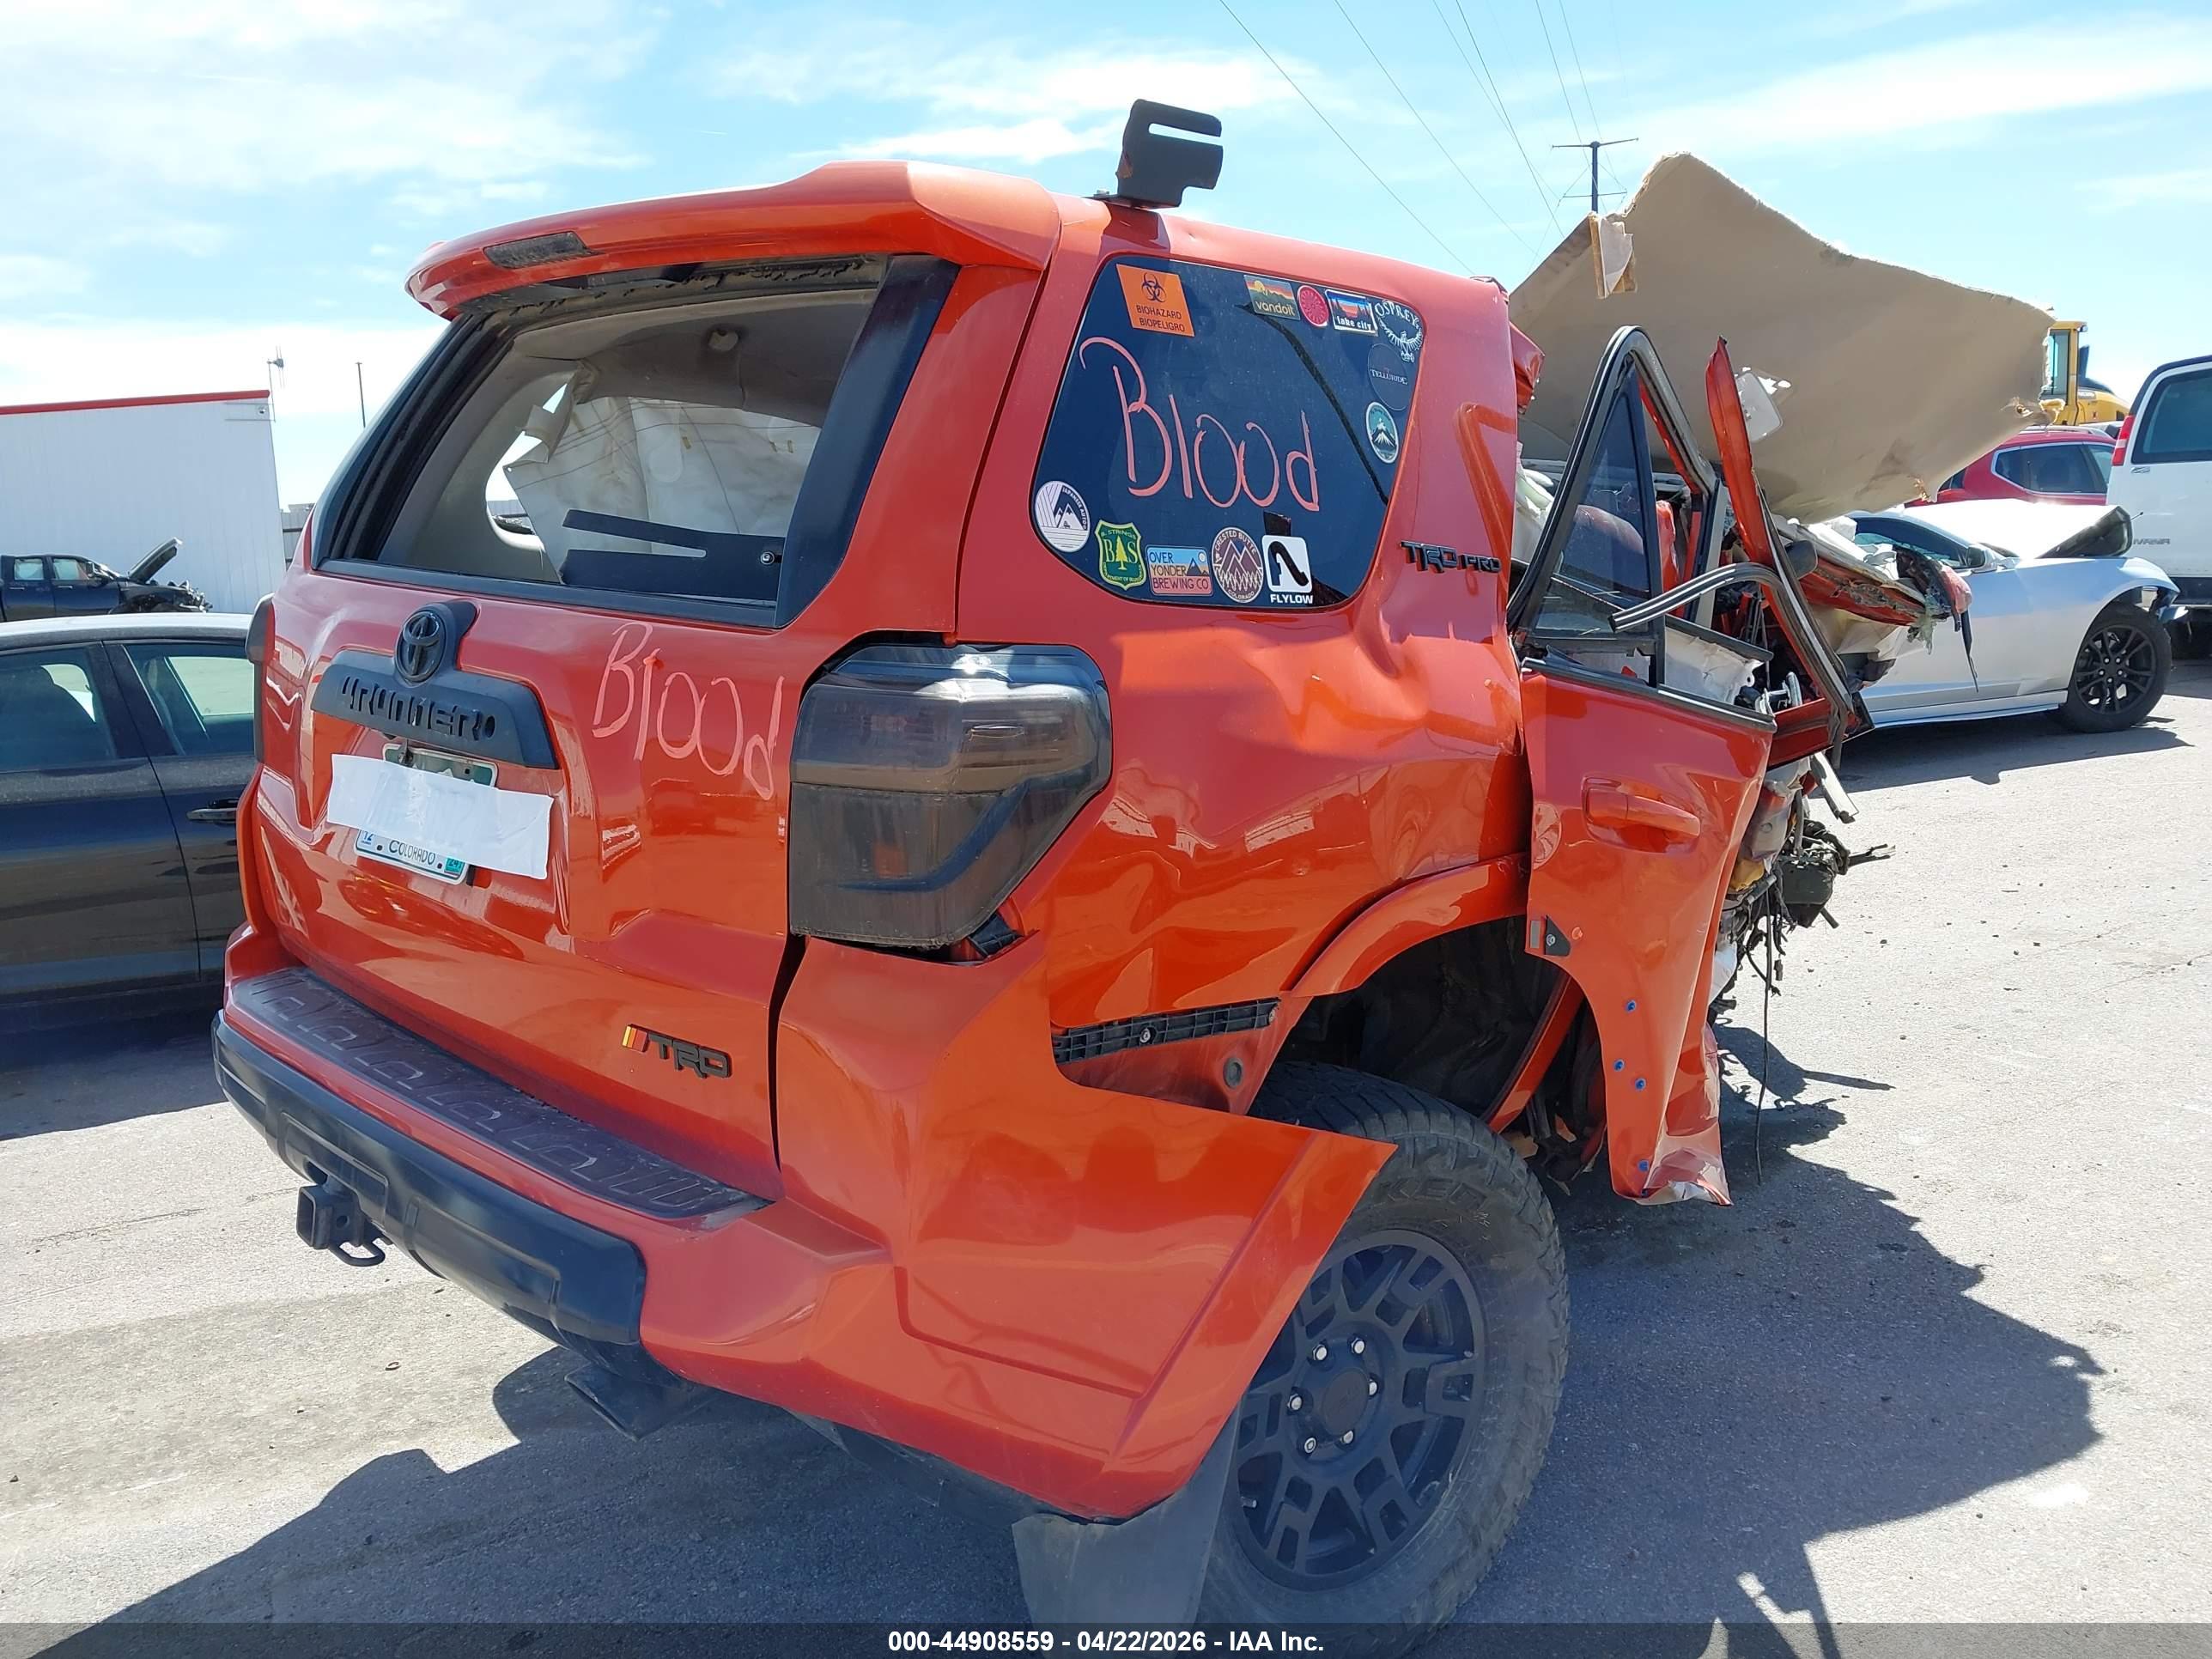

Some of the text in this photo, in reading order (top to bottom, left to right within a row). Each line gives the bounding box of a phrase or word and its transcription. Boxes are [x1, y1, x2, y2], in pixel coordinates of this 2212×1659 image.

[1136, 305, 1182, 320] BIOHAZARD
[1255, 301, 1296, 316] vandoit
[1374, 301, 1419, 326] OSPREY
[1139, 318, 1185, 332] BIOPELIGRO
[1336, 315, 1371, 331] lake city
[1079, 337, 1320, 511] Blood
[1214, 530, 1257, 555] CRESTED BUTTE
[1149, 551, 1174, 564] OVER
[1401, 540, 1502, 574] TRD PRO
[1151, 565, 1187, 577] YONDER
[1153, 577, 1209, 590] BREWING CO
[1270, 594, 1314, 605] FLYLOW
[592, 623, 786, 800] Blood
[388, 839, 436, 866] COLORADO
[647, 1030, 733, 1079] TRD
